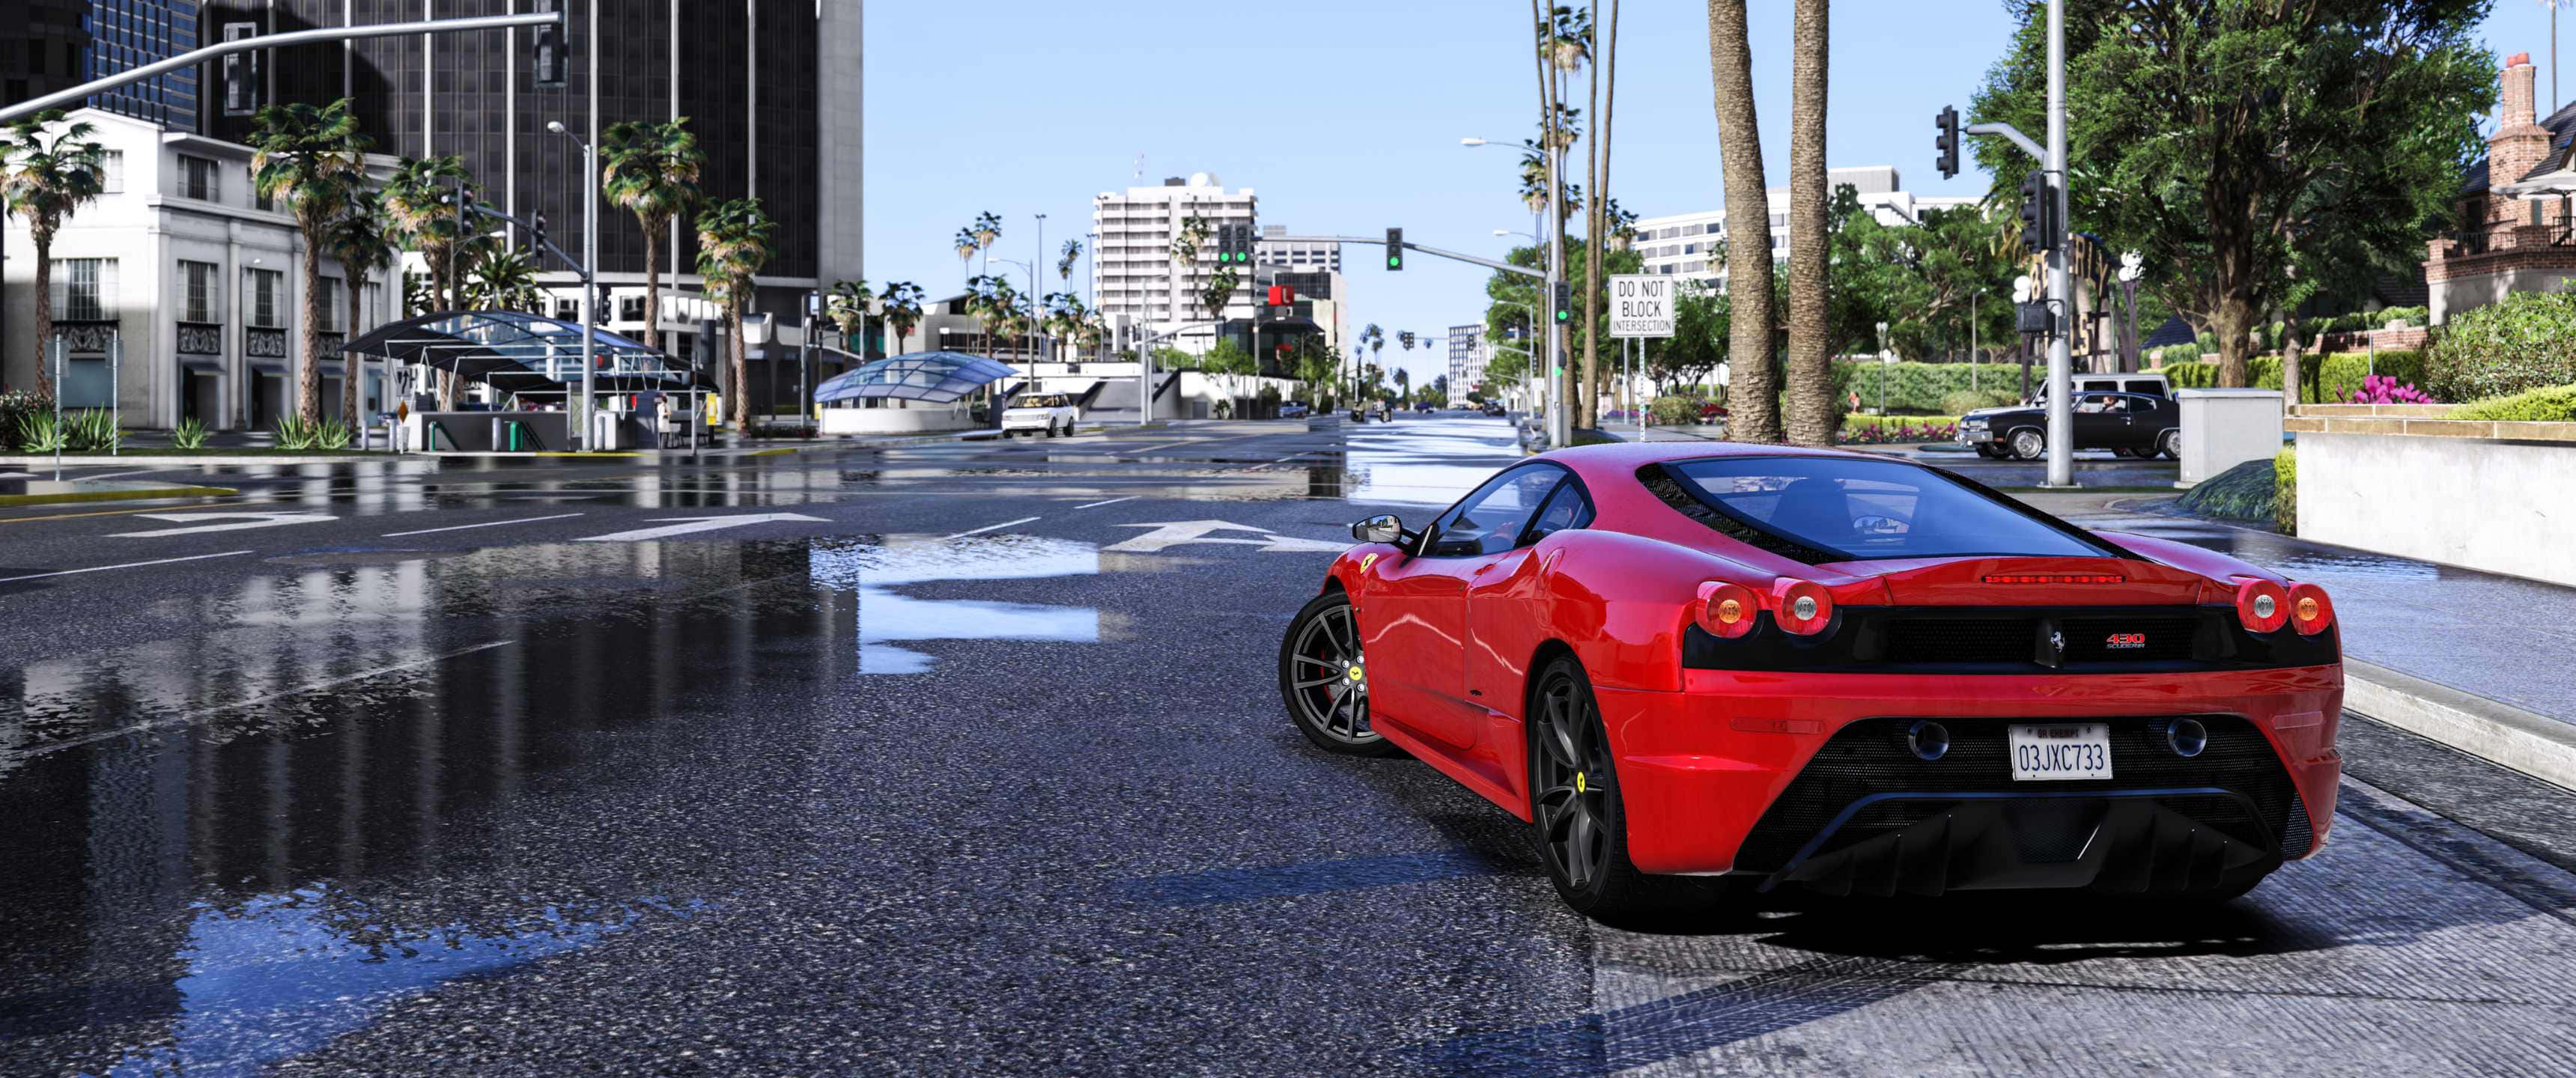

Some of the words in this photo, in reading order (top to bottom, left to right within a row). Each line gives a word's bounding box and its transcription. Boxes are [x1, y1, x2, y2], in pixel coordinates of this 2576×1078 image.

[1618, 281, 1635, 297] DO
[1642, 281, 1665, 297] NOT
[1622, 301, 1662, 317] BLOCK
[1613, 320, 1671, 332] INTERSECTION
[2106, 633, 2145, 644] 430
[2019, 743, 2104, 772] 03JXC733
